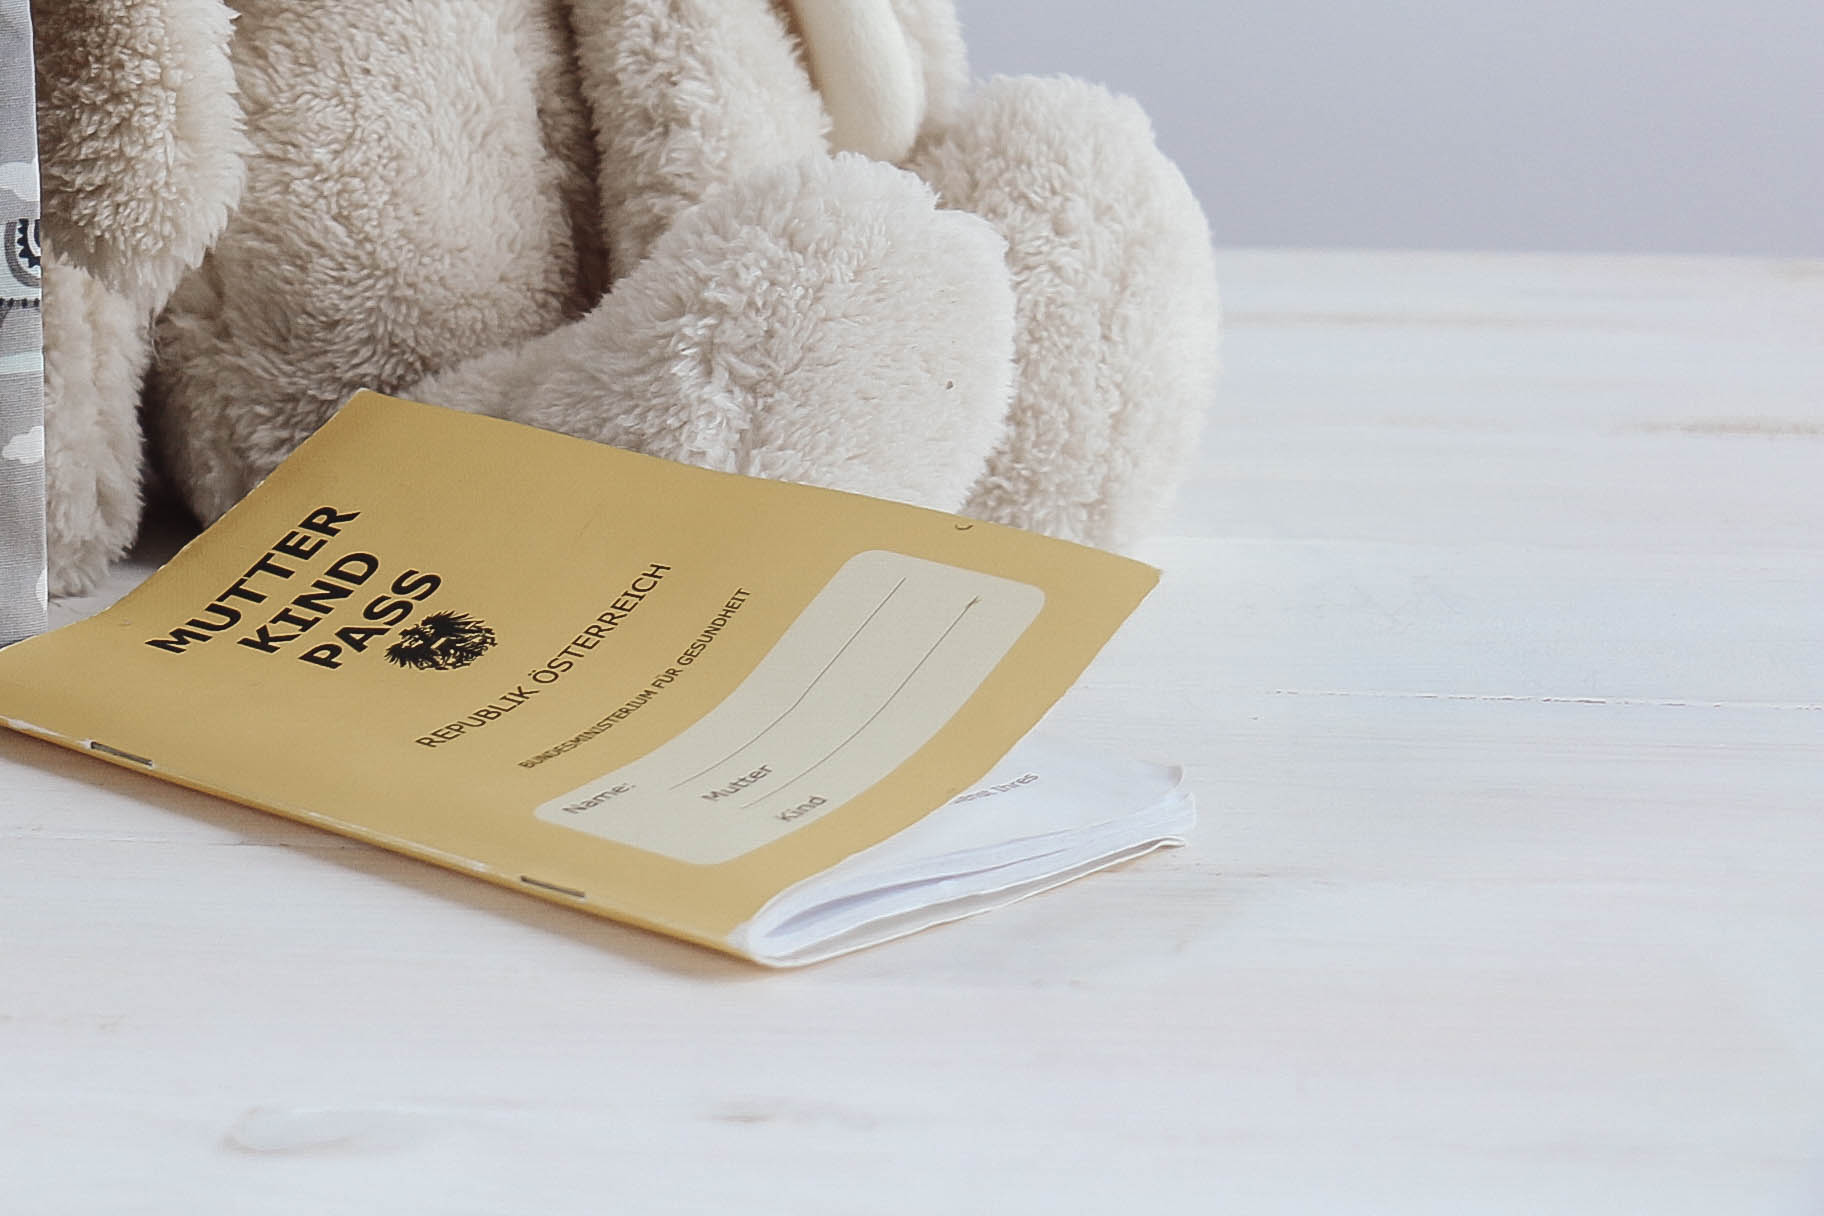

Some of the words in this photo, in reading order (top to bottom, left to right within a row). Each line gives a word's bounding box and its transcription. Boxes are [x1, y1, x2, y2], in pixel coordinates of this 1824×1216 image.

[144, 505, 361, 654] MUTTER
[236, 552, 379, 655] KIND
[297, 569, 442, 670] PASS
[415, 685, 540, 748] REPUBLIK
[528, 562, 671, 685] ÖSTERREICH
[517, 689, 658, 769] BUNDESMINISTERIUM
[651, 667, 685, 690] FÜR
[676, 587, 751, 667] GESUNDHEIT
[562, 781, 637, 816] Name:
[701, 763, 773, 803] Mutter
[775, 794, 828, 823] Kind
